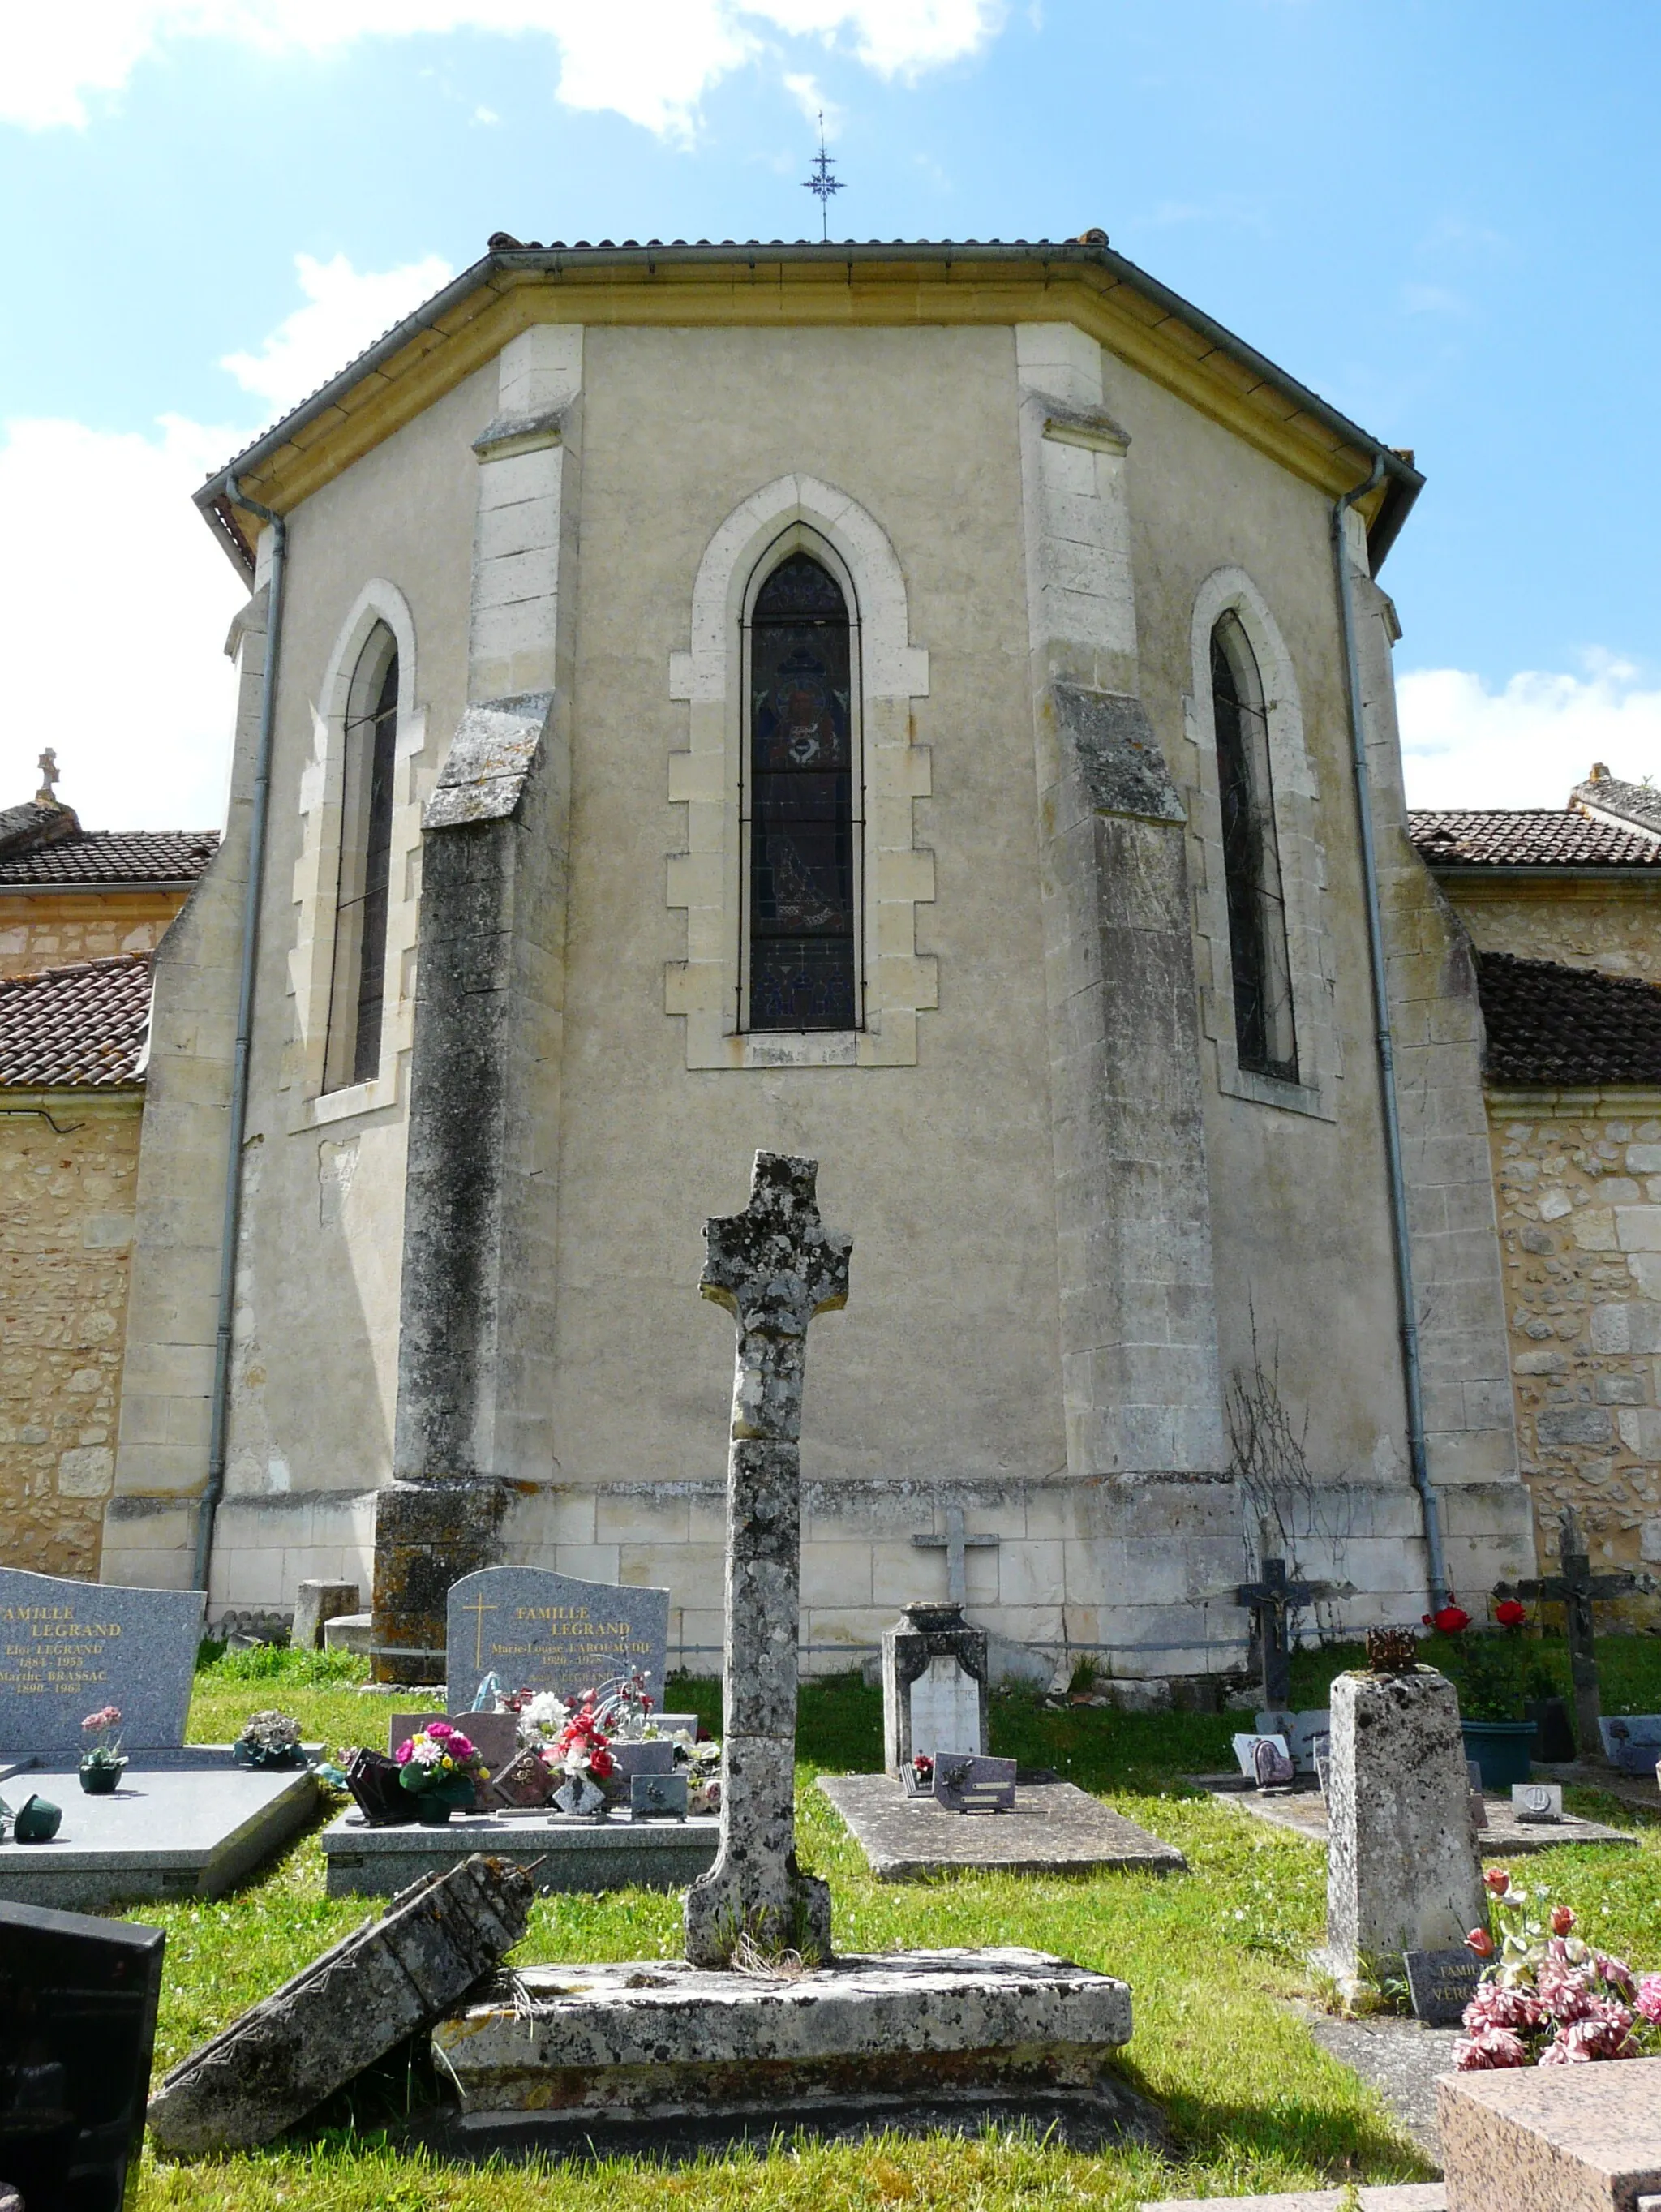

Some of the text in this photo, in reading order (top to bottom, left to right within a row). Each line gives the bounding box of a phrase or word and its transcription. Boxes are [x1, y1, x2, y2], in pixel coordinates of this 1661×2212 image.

[0, 1607, 74, 1620] AMILLE
[517, 1607, 590, 1620] FAMILLE
[32, 1624, 121, 1637] LEGRAND
[552, 1622, 632, 1636] LEGRAND
[36, 1644, 104, 1655] LEGRAND
